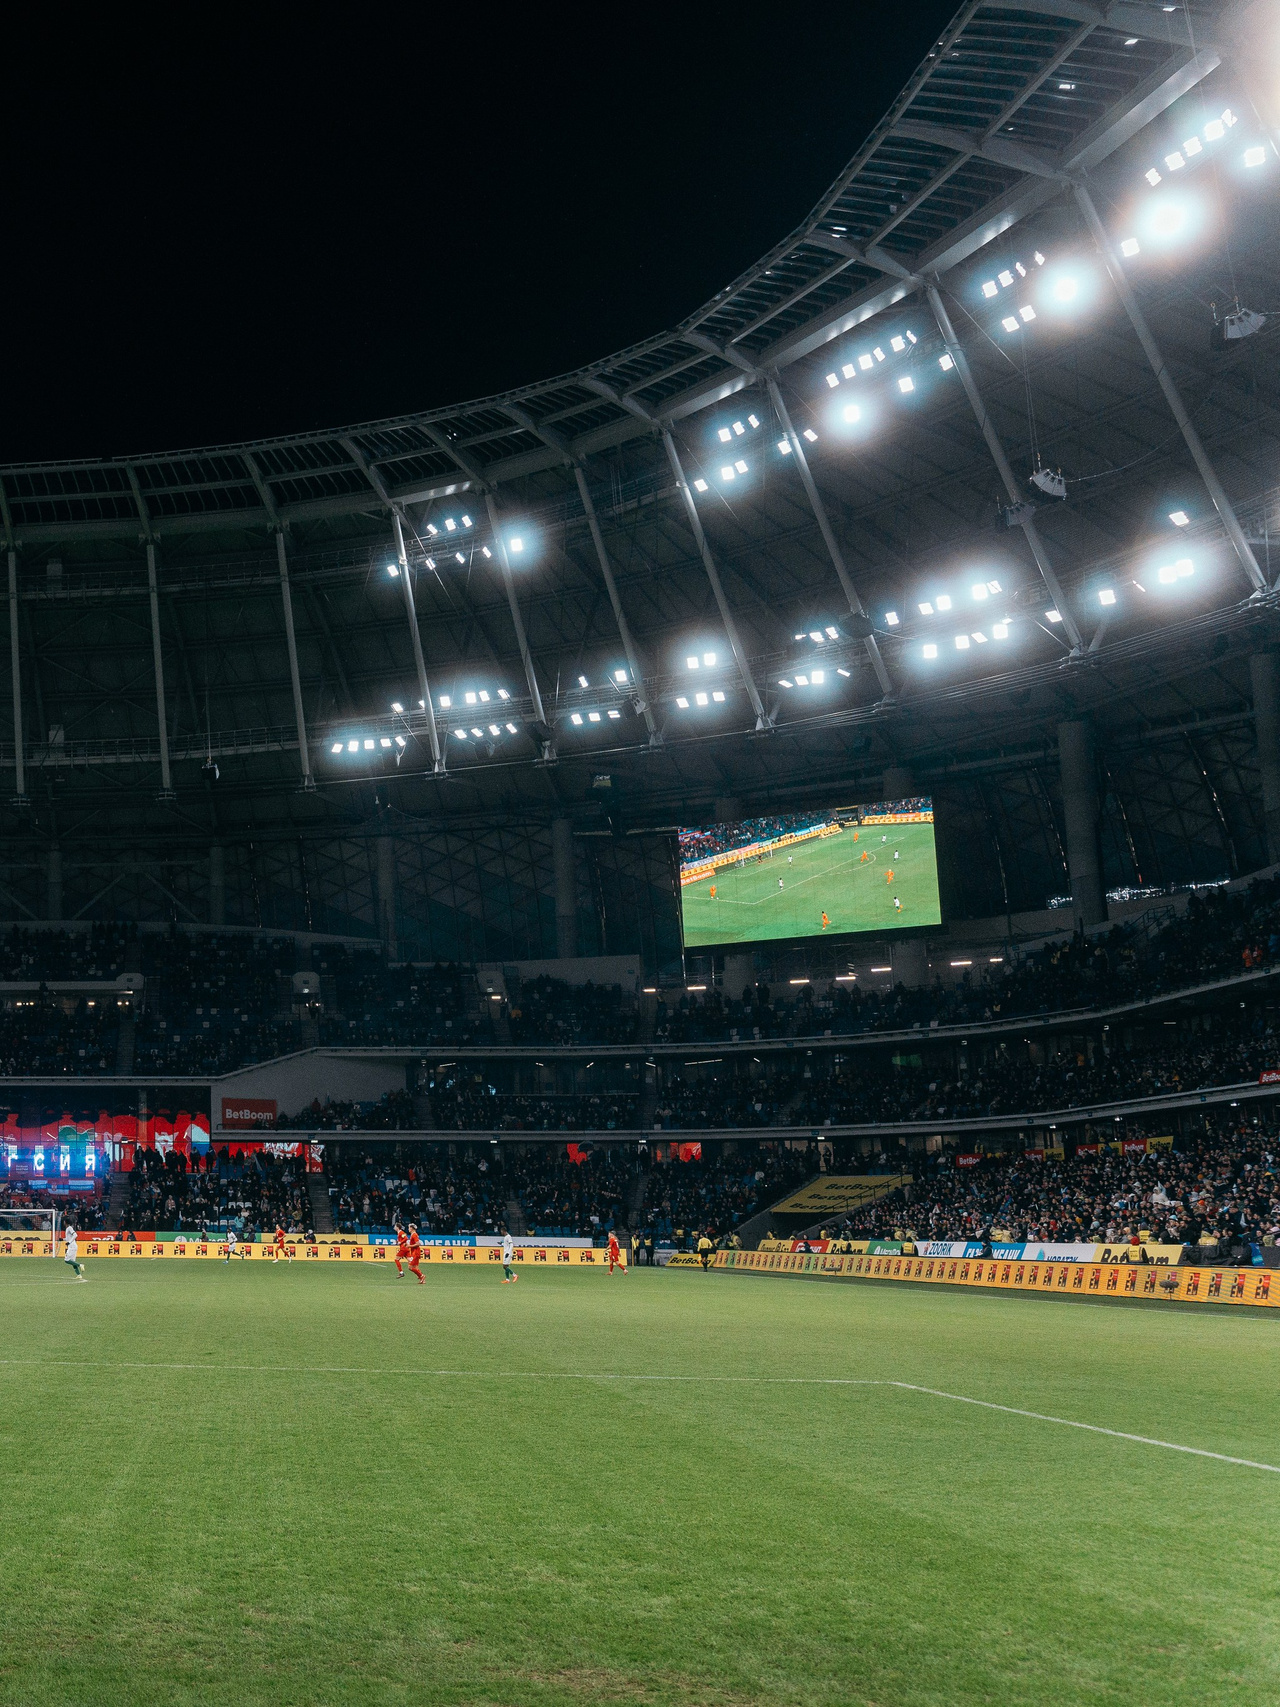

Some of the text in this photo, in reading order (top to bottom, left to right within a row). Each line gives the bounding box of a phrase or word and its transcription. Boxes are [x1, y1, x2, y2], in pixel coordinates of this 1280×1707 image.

[225, 1108, 274, 1120] BetBoom
[959, 1156, 981, 1165] BetBoo
[789, 1202, 855, 1210] BetB
[928, 1242, 954, 1256] ZOORIK
[669, 1256, 711, 1265] BetBo
